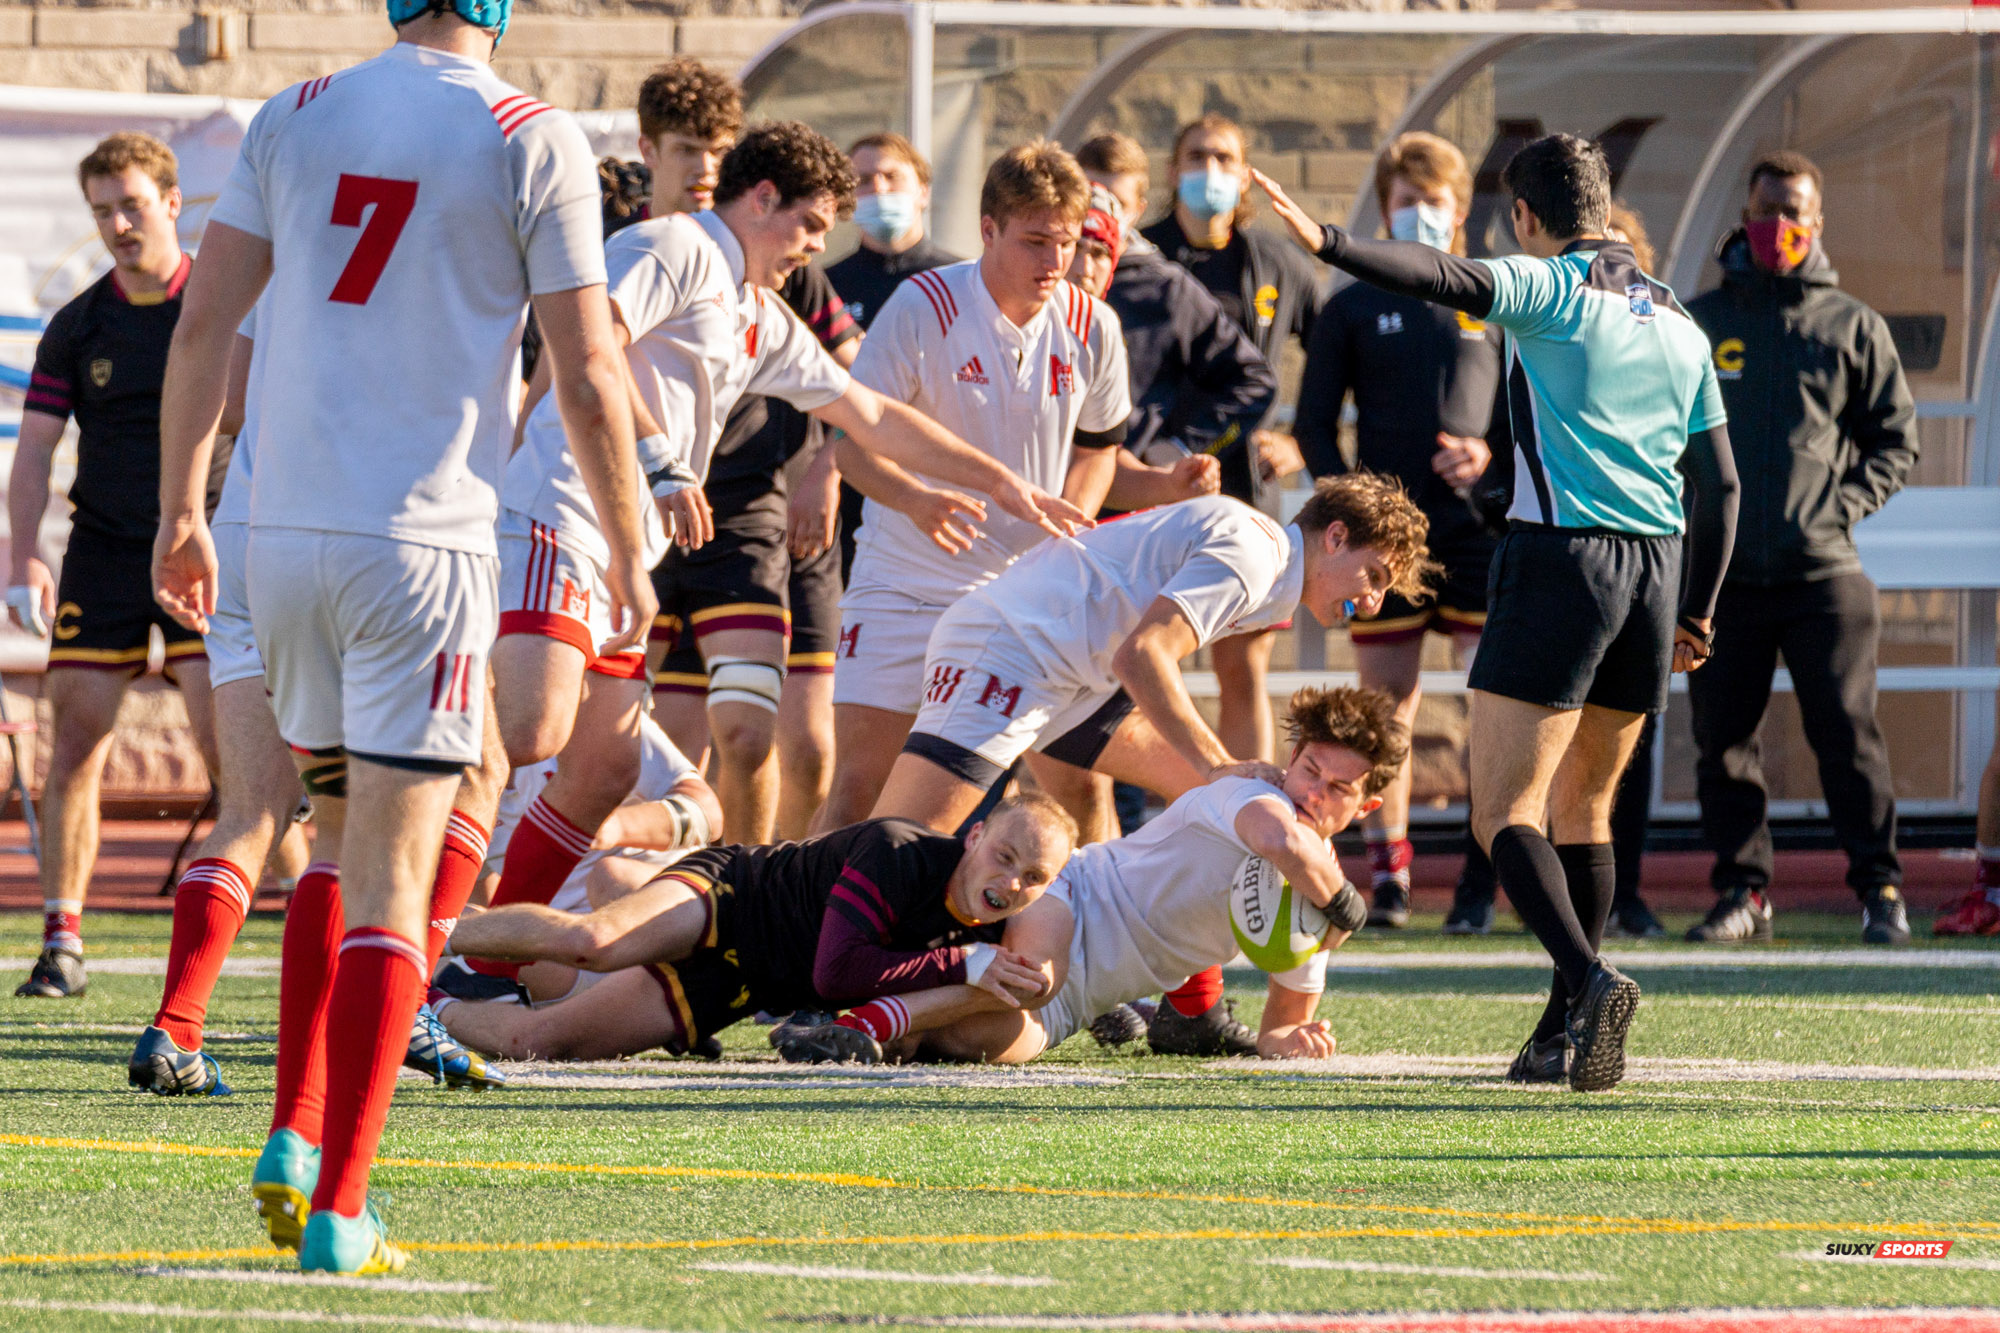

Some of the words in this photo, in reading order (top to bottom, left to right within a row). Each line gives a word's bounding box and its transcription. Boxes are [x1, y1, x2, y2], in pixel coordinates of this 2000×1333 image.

[328, 173, 420, 306] 7
[1715, 337, 1745, 371] C
[957, 372, 989, 385] adidas
[55, 601, 83, 640] C
[975, 673, 1024, 719] M
